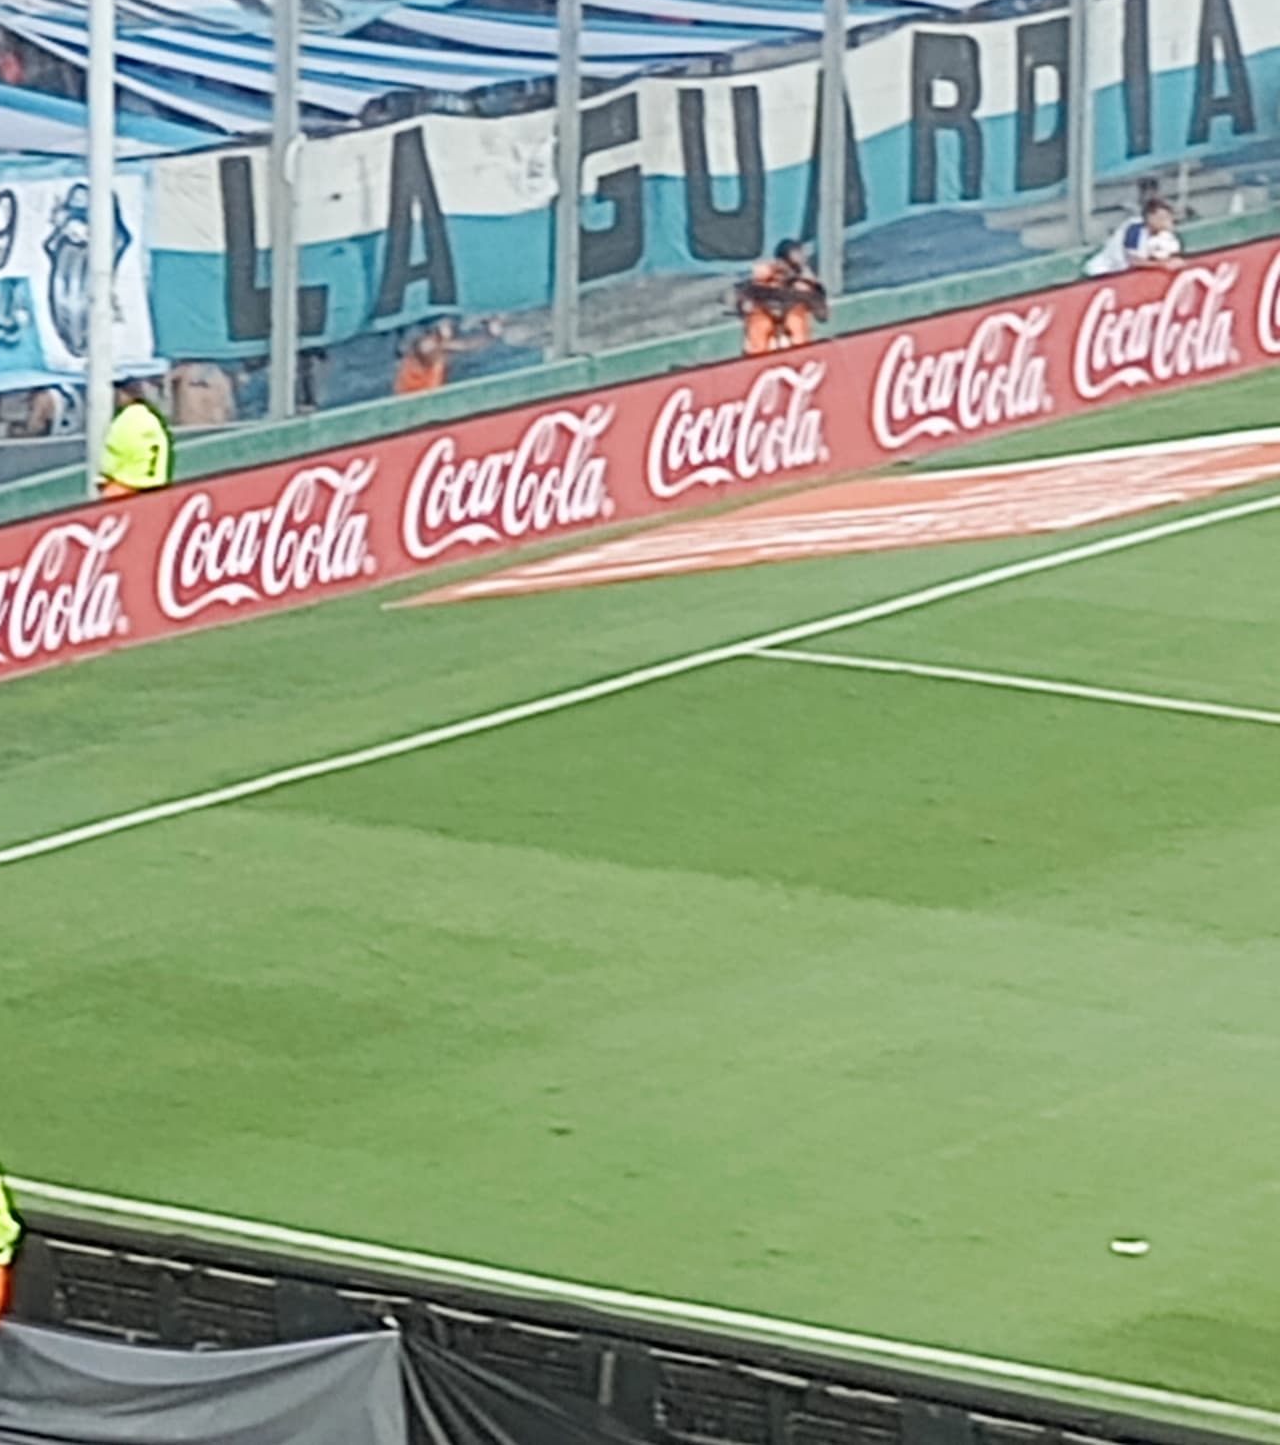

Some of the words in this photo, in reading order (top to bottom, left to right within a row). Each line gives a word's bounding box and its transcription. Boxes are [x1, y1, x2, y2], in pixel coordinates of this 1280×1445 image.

[218, 124, 460, 343] LA
[872, 305, 1055, 450] Coca-Cola
[1072, 261, 1241, 399] Coca-Cola
[402, 402, 617, 560] Coca-Cola
[646, 360, 827, 499] Coca-Cola
[157, 456, 380, 620] Coca-Cola
